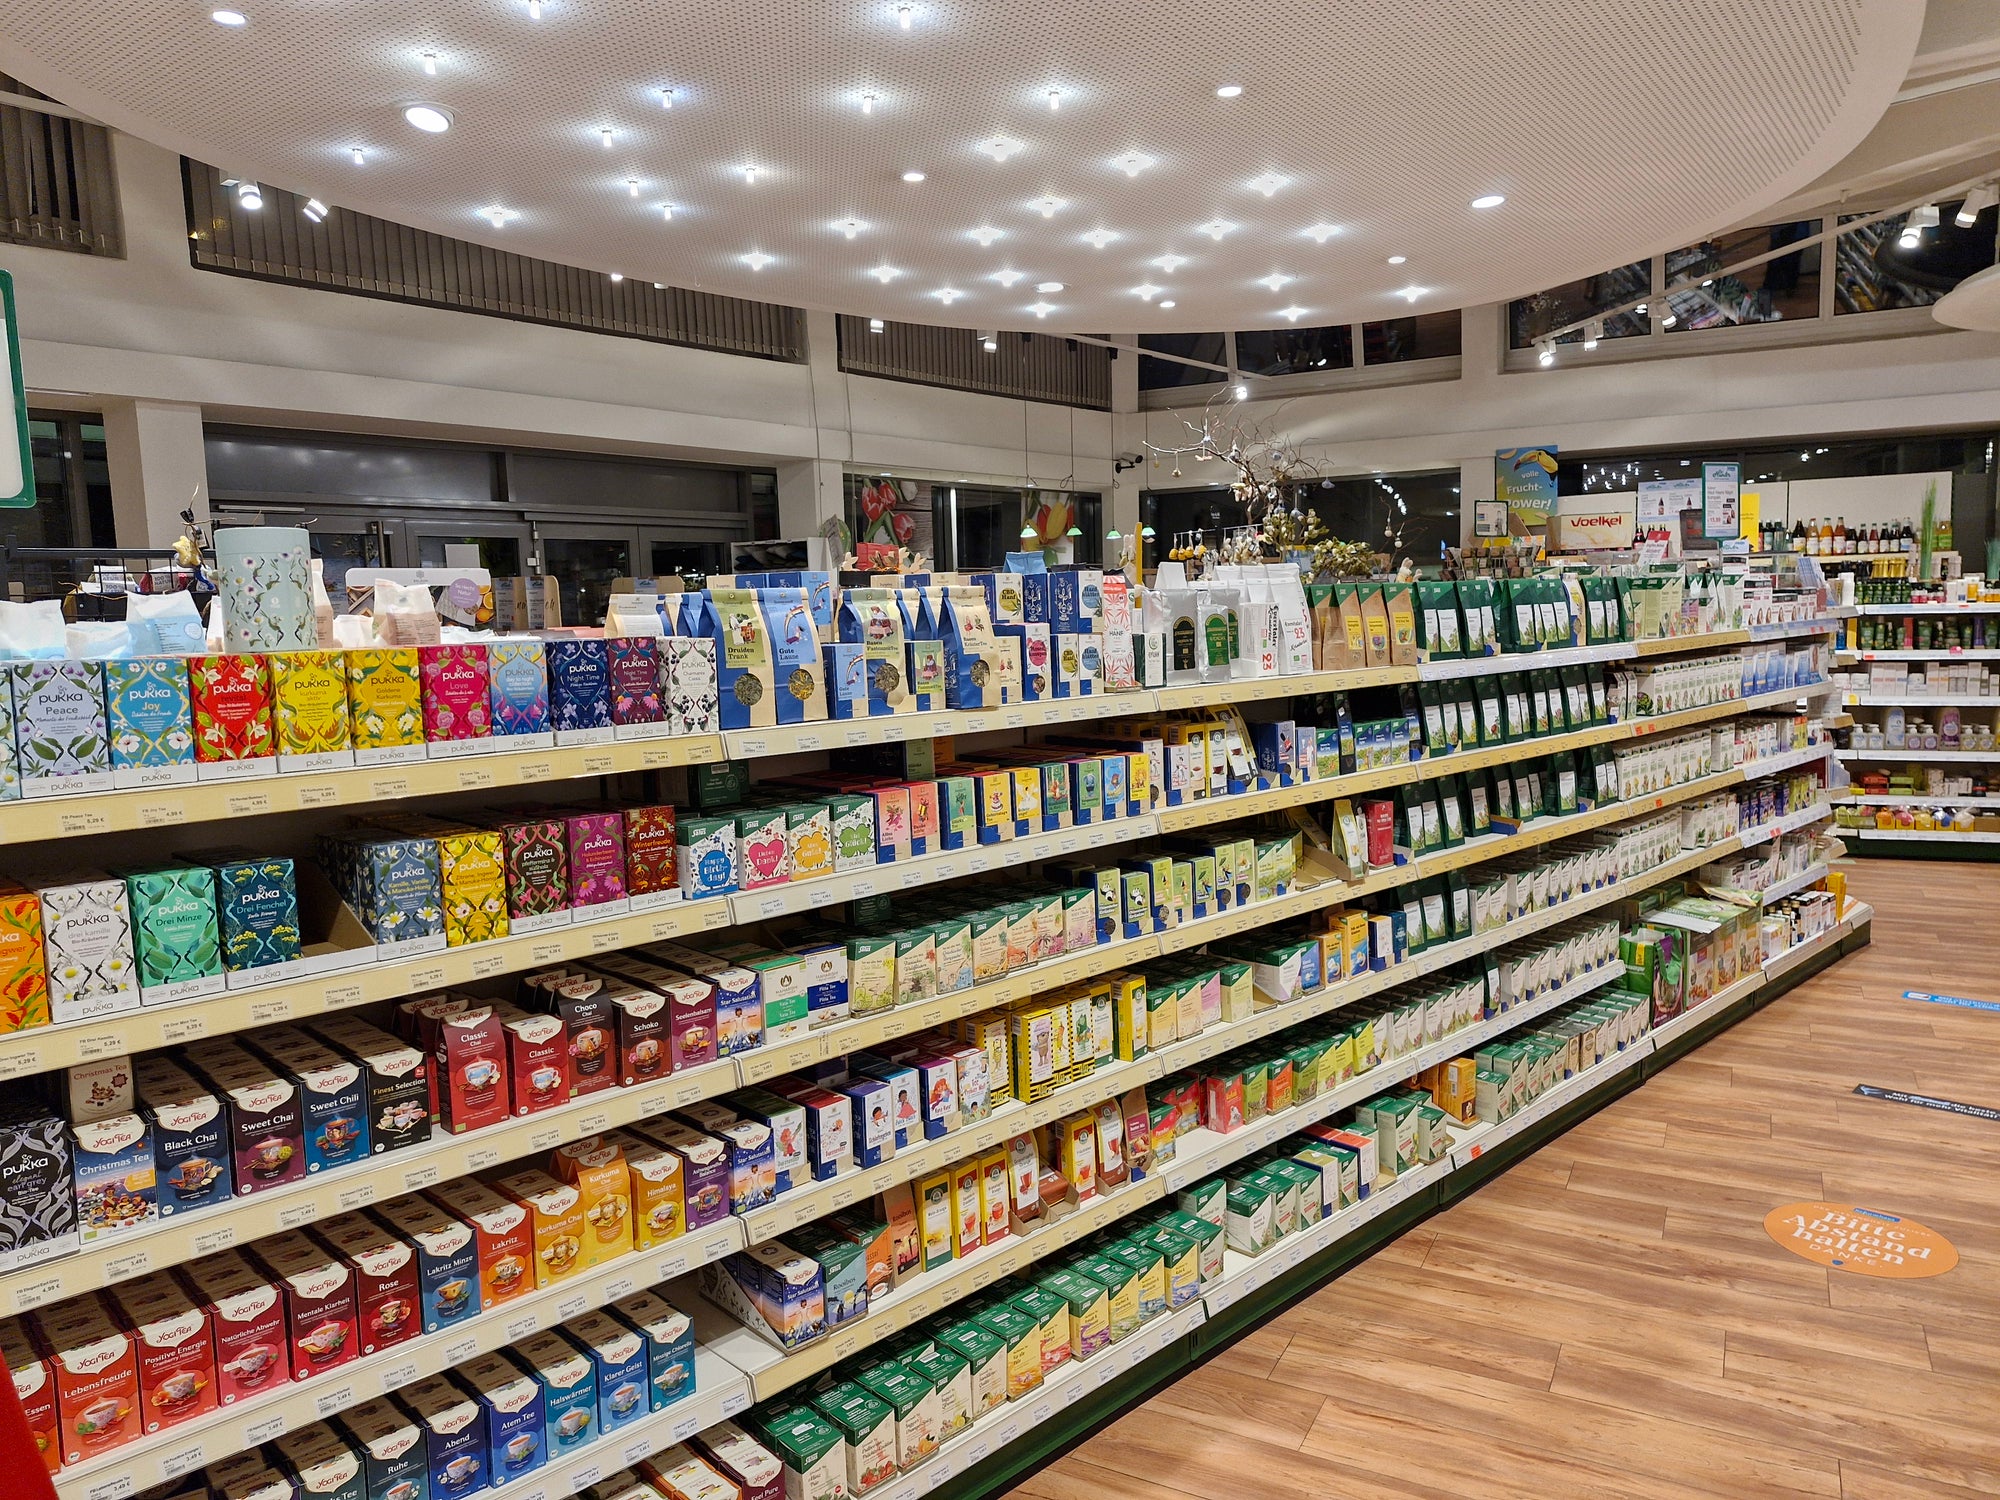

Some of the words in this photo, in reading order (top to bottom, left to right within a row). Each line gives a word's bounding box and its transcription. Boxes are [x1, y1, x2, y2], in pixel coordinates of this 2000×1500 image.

[1522, 470, 1540, 478] volle
[1506, 484, 1543, 494] Frucht-
[1570, 516, 1622, 528] Voelkel
[1294, 628, 1305, 638] 23
[569, 661, 596, 674] pukka
[622, 658, 648, 669] pukka
[371, 672, 404, 686] pukka
[442, 668, 475, 682] pukka
[213, 680, 252, 695] pukka
[296, 679, 330, 690] pukka
[39, 690, 83, 705] pukka
[130, 686, 170, 700] pukka
[46, 706, 78, 714] Peace
[142, 702, 160, 711] Joy
[640, 828, 664, 840] pukka
[584, 836, 612, 850] pukka
[634, 839, 671, 849] Winterfreude
[524, 846, 552, 860] pukka
[704, 857, 724, 866] Happy
[392, 866, 425, 880] pukka
[242, 887, 280, 904] pukka
[158, 899, 199, 917] pukka
[236, 905, 254, 914] Drei
[255, 900, 288, 912] Fenchel
[67, 912, 110, 930] pukka
[156, 917, 173, 926] Drei
[175, 913, 202, 924] Minze
[574, 1002, 598, 1013] Choco
[720, 998, 733, 1006] Star
[676, 1007, 712, 1021] Seelenbalsam
[634, 1020, 659, 1032] Schoko
[460, 1030, 488, 1043] Classic
[529, 1048, 554, 1059] Classic
[74, 1066, 114, 1080] Christmas
[116, 1064, 128, 1073] Tea
[373, 1086, 394, 1096] Finest
[395, 1078, 426, 1090] Selection
[310, 1101, 337, 1112] Sweet
[340, 1094, 360, 1106] Chili
[242, 1120, 270, 1132] Sweet
[273, 1114, 294, 1125] Chai
[164, 1138, 192, 1152] Black
[195, 1132, 218, 1144] Chai
[3, 1156, 48, 1178] pukka
[80, 1158, 130, 1176] Christmas
[132, 1154, 149, 1162] Tea
[737, 1156, 750, 1164] Star
[589, 1169, 620, 1183] Kurkuma
[646, 1182, 677, 1198] Himalaya
[537, 1218, 566, 1235] Kurkuma
[568, 1214, 583, 1224] Chai
[1822, 1212, 1906, 1241] Bitte
[492, 1236, 518, 1251] Lakritz
[1782, 1214, 1931, 1260] Abstand
[1792, 1226, 1904, 1265] halten
[426, 1263, 451, 1276] Lakritz
[452, 1254, 473, 1267] Minze
[378, 1279, 399, 1292] Rose
[833, 1277, 856, 1290] Rooibos
[787, 1292, 799, 1300] Star
[297, 1308, 323, 1320] Mentale
[324, 1297, 350, 1312] Klarheit
[221, 1327, 254, 1344] Natürliche
[256, 1318, 280, 1332] Abwehr
[144, 1348, 176, 1365] Positive
[178, 1339, 207, 1354] Energie
[653, 1349, 670, 1362] Minzige
[604, 1368, 624, 1383] Klarer
[626, 1362, 643, 1375] Geist
[64, 1369, 132, 1398] Lebensfreude
[550, 1385, 592, 1407] Halswärmer
[24, 1404, 51, 1416] Essen
[501, 1417, 521, 1430] Atem
[522, 1411, 535, 1422] Tee
[445, 1434, 470, 1450] Abend
[388, 1460, 409, 1474] Ruhe
[340, 1490, 358, 1500] Tee
[766, 1486, 778, 1495] Pure
